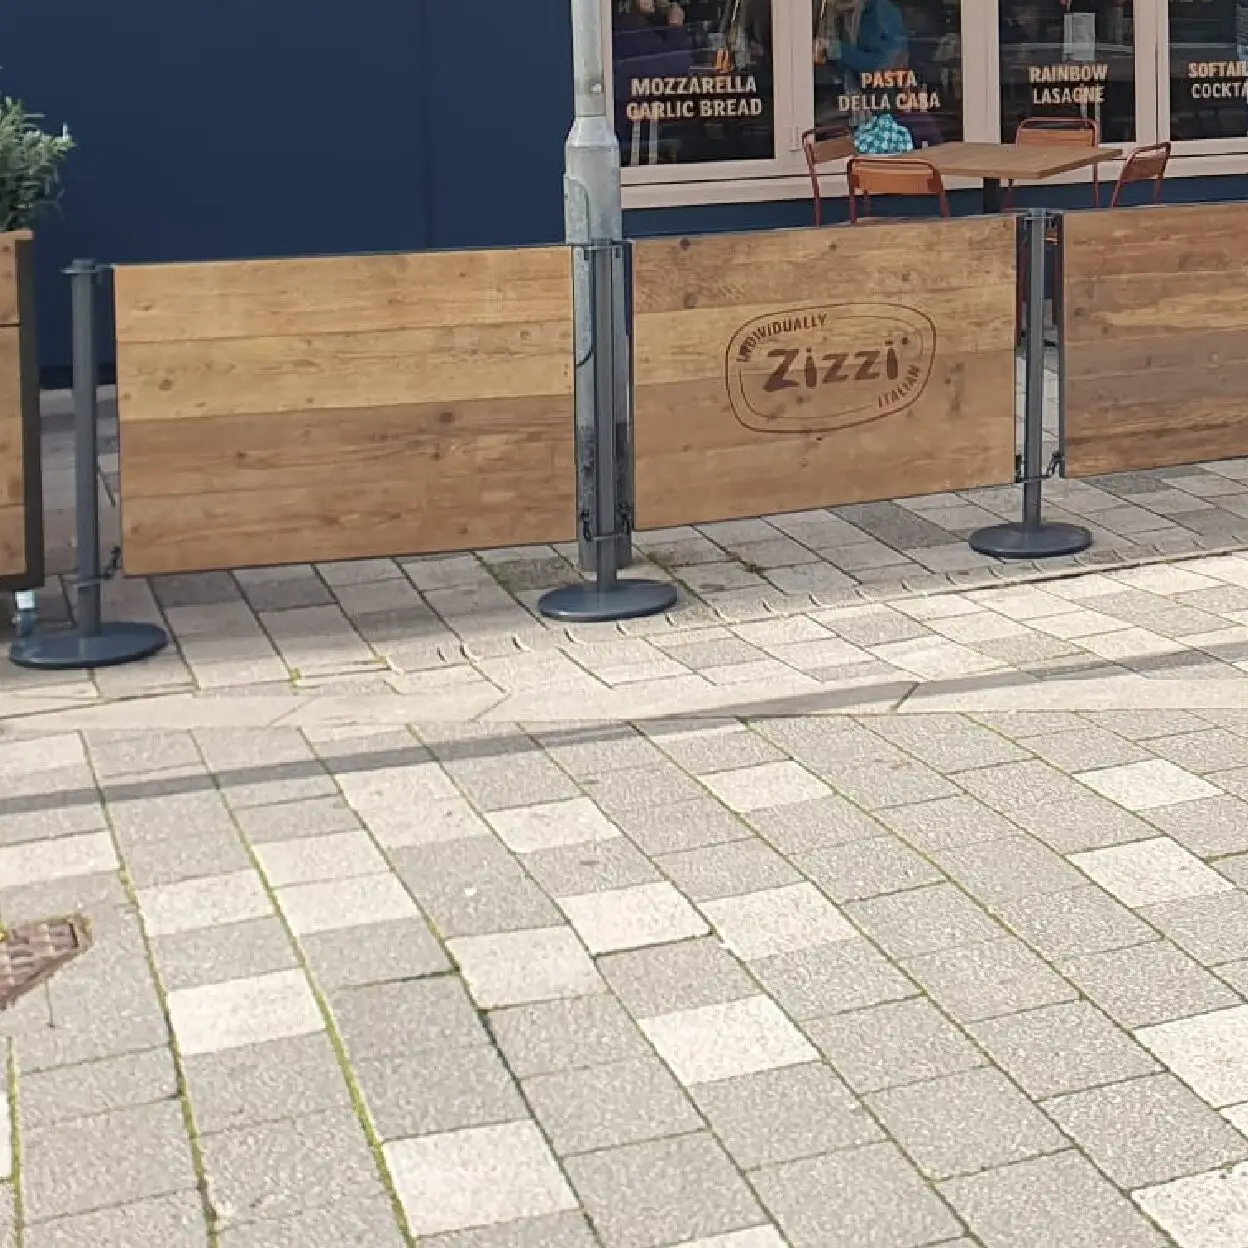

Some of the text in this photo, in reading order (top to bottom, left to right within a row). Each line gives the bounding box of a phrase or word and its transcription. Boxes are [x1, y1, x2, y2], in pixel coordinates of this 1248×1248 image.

[859, 70, 917, 89] PASTA
[1029, 64, 1108, 83] RAINBOW
[631, 74, 757, 96] MOZZARELLA
[1033, 85, 1106, 105] LASAGNE
[626, 97, 763, 120] GARLIC BREAD
[837, 91, 941, 112] DELLA CASA
[762, 340, 899, 393] Zizzi
[876, 364, 922, 409] ITALIAN
